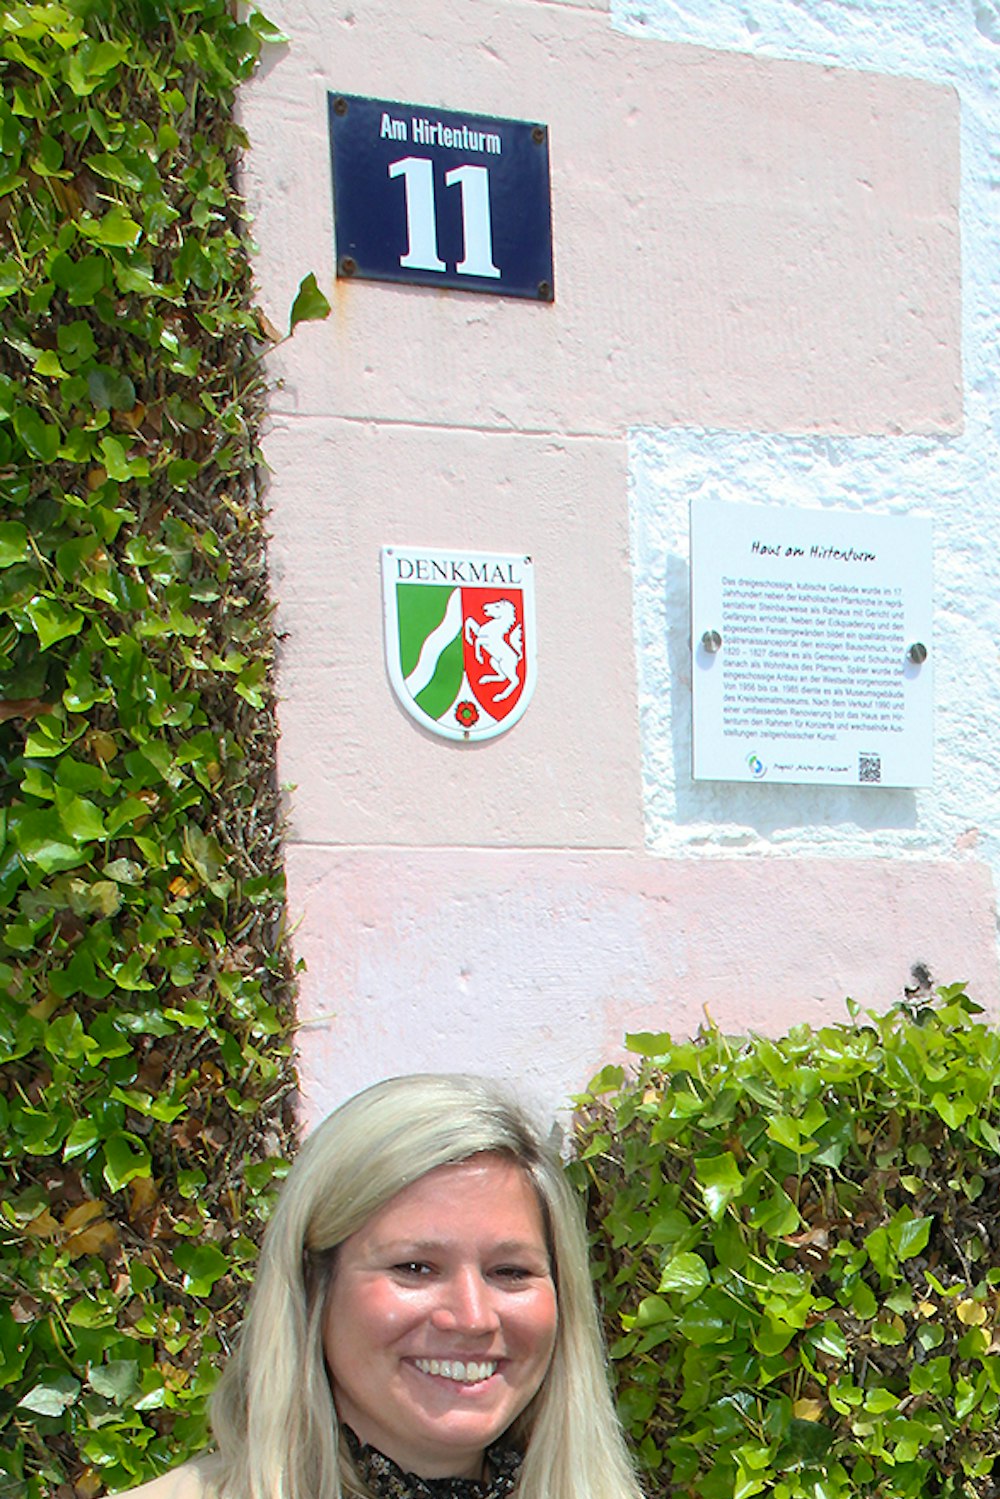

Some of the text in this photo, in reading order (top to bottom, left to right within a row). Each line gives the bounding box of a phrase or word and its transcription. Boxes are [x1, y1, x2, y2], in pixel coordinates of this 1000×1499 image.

[380, 113, 502, 155] Am Hirtenturm
[388, 156, 501, 279] 11
[751, 541, 876, 561] Haus am Hirtenturm
[397, 559, 522, 584] DENKMAL
[721, 576, 735, 585] Das
[738, 577, 794, 590] dreigeschossige,
[796, 581, 826, 591] kubische
[828, 583, 858, 593] Gebäude
[861, 585, 881, 594] wurde
[883, 587, 891, 595] im
[722, 588, 762, 598] Jahrhundert
[764, 591, 784, 600] neben
[798, 593, 838, 603] katholischen
[840, 596, 875, 605] Pfarrkirche
[877, 598, 882, 606] in
[884, 598, 903, 609] reprä-
[722, 600, 904, 619] sentativer Steinbauweise als Rathaus mit Gericht und
[722, 611, 756, 623] Gefängnis
[790, 616, 812, 624] Neben
[877, 621, 889, 629] und
[892, 622, 904, 630] den
[722, 623, 763, 635] abgesetzten
[765, 626, 824, 639] Fenstergewänden
[826, 629, 844, 638] bildet
[846, 630, 856, 639] ein
[723, 635, 798, 649] Spätrenaissanceportal
[800, 639, 812, 648] den
[815, 640, 842, 651] einzigen
[890, 645, 903, 653] Von
[768, 649, 789, 658] diente
[802, 651, 812, 659] als
[814, 652, 850, 661] Gemeinde-
[853, 654, 865, 662] und
[722, 658, 747, 667] danach
[750, 660, 760, 668] als
[763, 660, 798, 670] Wohnhaus
[800, 663, 812, 671] des
[847, 665, 868, 676] Später
[871, 666, 891, 675] wurde
[723, 670, 774, 682] eingeschossige
[776, 673, 797, 681] Anbau
[822, 675, 854, 684] Westseite
[723, 682, 736, 690] Von
[757, 683, 767, 691] bis
[800, 686, 821, 694] diente
[833, 687, 843, 695] als
[845, 688, 904, 700] Museumsgebäude
[723, 693, 735, 701] des
[812, 697, 829, 706] Nach
[831, 698, 845, 707] dem
[847, 699, 872, 708] Verkauf
[892, 702, 904, 710] und
[723, 705, 740, 713] einer
[742, 706, 787, 715] umfassenden
[789, 708, 831, 719] Renovierung
[833, 710, 844, 718] bot
[846, 711, 858, 719] das
[860, 711, 877, 720] Haus
[892, 713, 903, 721] Hir-
[723, 716, 904, 732] tenturm den Rahmen für Konzerte und wechselnde Aus-
[723, 727, 757, 738] stellungen
[760, 729, 814, 741] zeitgenössischer
